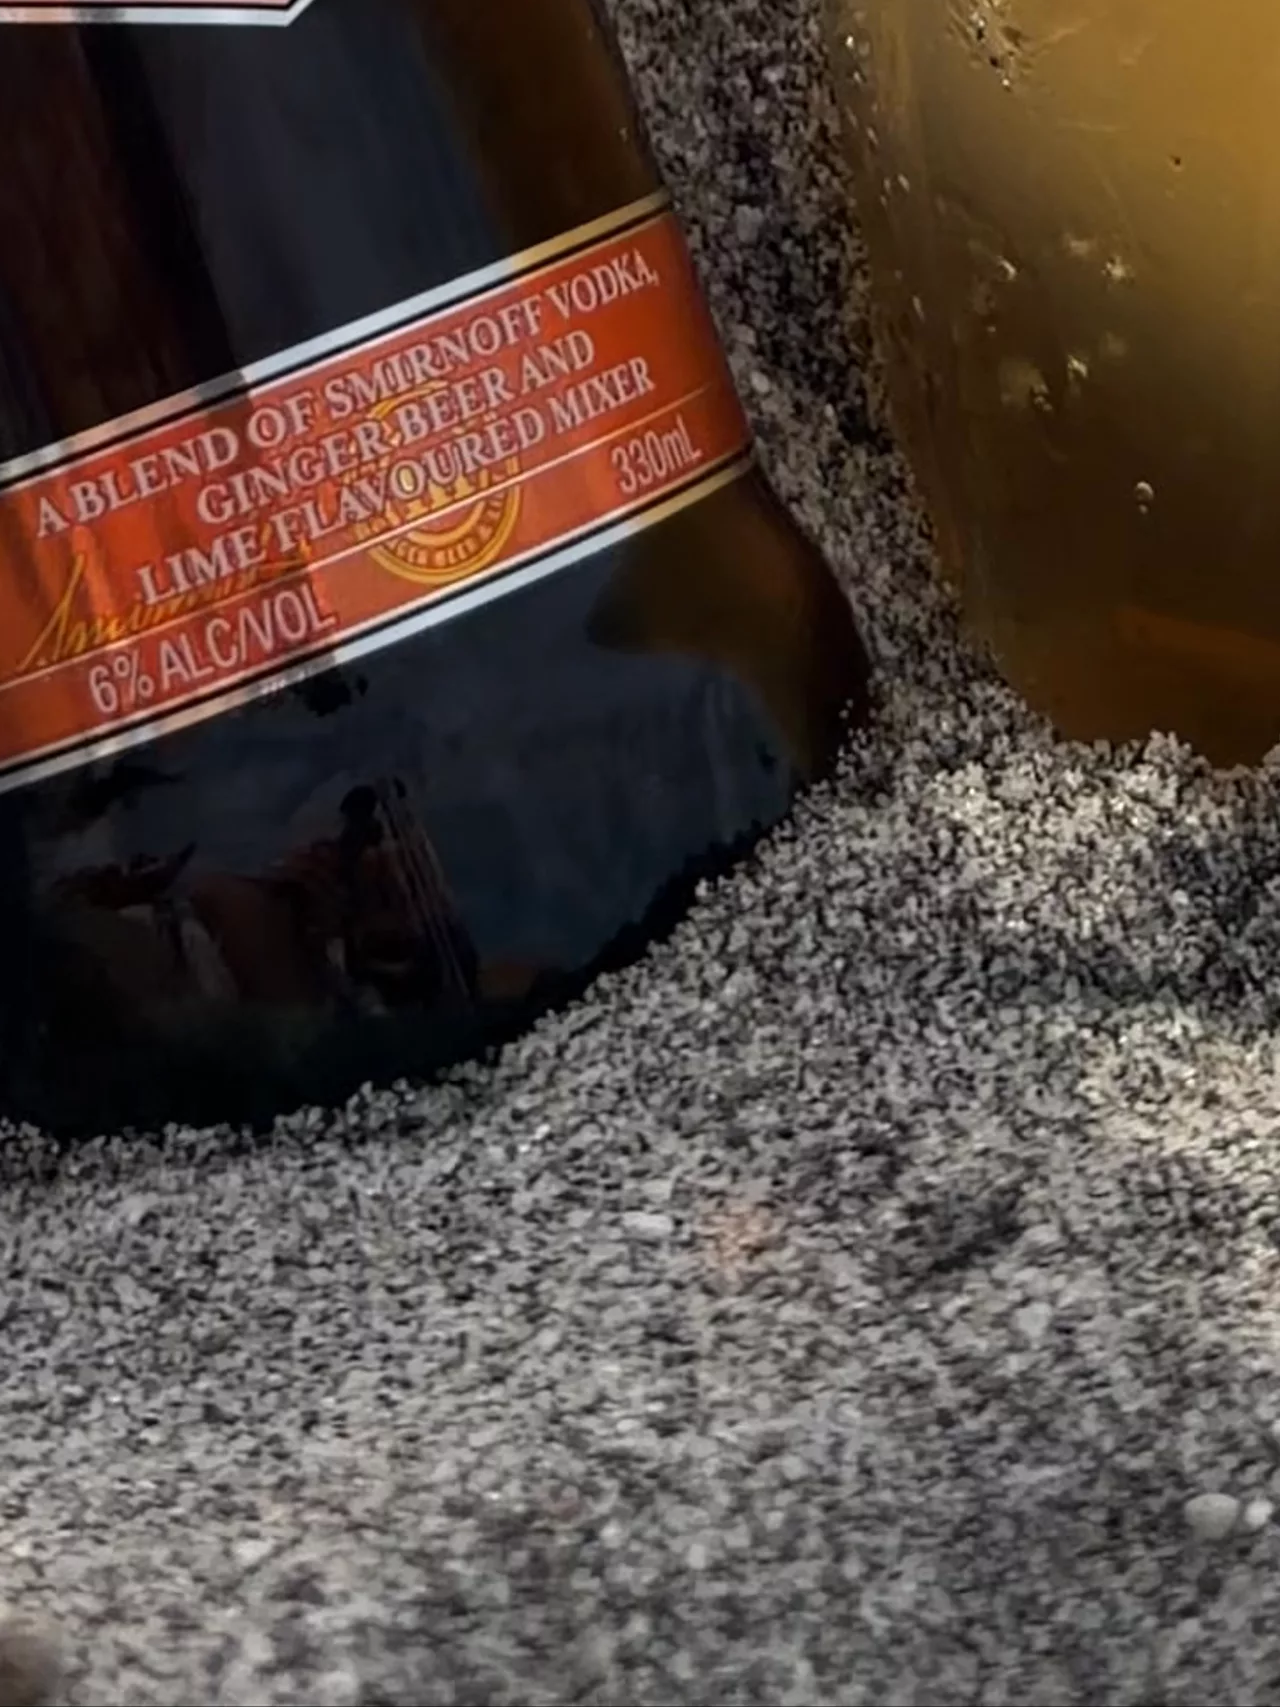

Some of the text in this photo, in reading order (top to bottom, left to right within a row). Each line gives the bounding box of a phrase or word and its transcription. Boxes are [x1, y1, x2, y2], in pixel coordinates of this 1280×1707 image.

[37, 497, 69, 539] A
[70, 426, 239, 523] BLEND
[248, 391, 315, 448] OF
[324, 294, 542, 419] SMIRNOFF
[137, 525, 267, 605] LIME
[272, 406, 544, 554] FLAVOURED
[550, 356, 655, 434] MIXER
[197, 421, 393, 523] GINGER
[396, 367, 513, 445] BEER
[522, 329, 594, 393] AND
[611, 413, 702, 494] 330mL
[87, 650, 154, 713] 6%
[158, 583, 336, 690] ALC/VOL
